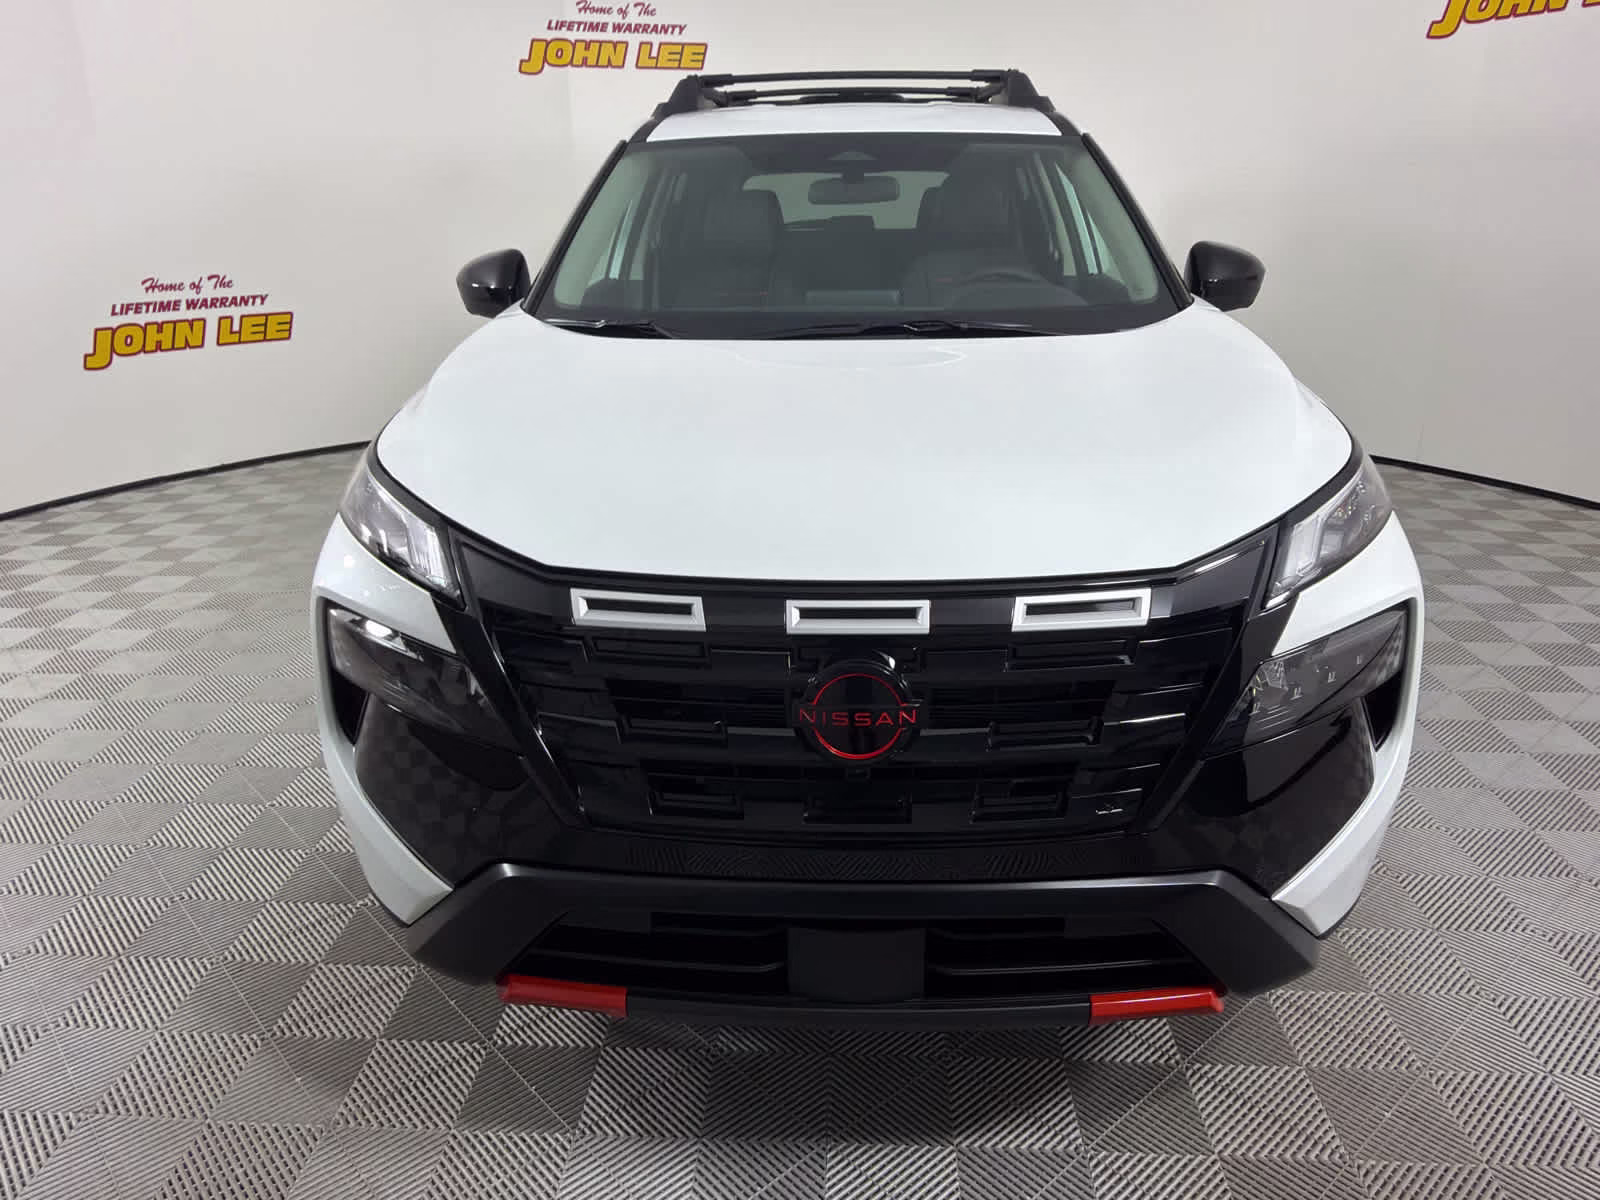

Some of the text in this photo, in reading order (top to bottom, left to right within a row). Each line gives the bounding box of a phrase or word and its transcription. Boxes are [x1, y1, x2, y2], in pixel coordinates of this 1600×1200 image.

[576, 0, 657, 20] Home of The
[547, 19, 688, 35] LIFETIME WARRANTY
[518, 38, 708, 75] JOHN LEE
[141, 274, 234, 295] Home of The
[110, 293, 269, 316] LIFETIME WARRANTY
[83, 311, 294, 371] JOHN LEE
[799, 708, 917, 727] NISSAN
